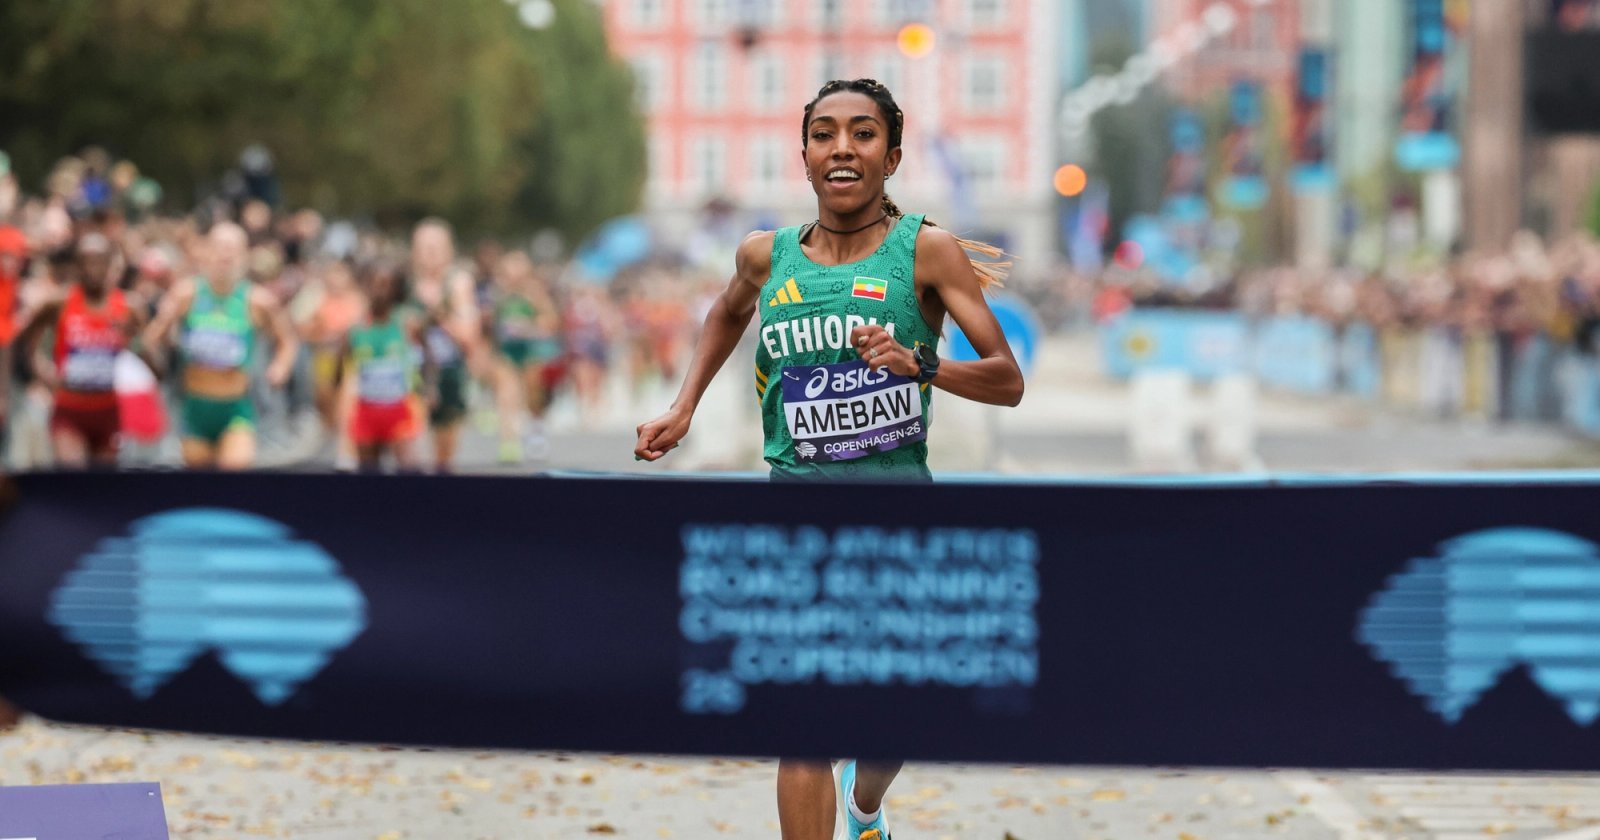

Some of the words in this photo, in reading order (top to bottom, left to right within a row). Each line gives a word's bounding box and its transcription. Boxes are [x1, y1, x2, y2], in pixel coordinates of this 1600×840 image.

[762, 314, 895, 359] ETHIOP
[831, 365, 888, 392] asics
[794, 387, 911, 435] AMEBAW
[823, 428, 905, 454] COPENHAGEN
[681, 524, 828, 560] WORLD
[832, 526, 1038, 562] ATHLETICS
[680, 559, 817, 602] ROAD
[824, 562, 1038, 604] RUNNING
[679, 601, 1038, 643] CHAMPIONSHIPS
[731, 642, 1038, 685] COPENHAGEN
[680, 669, 746, 713] 26
